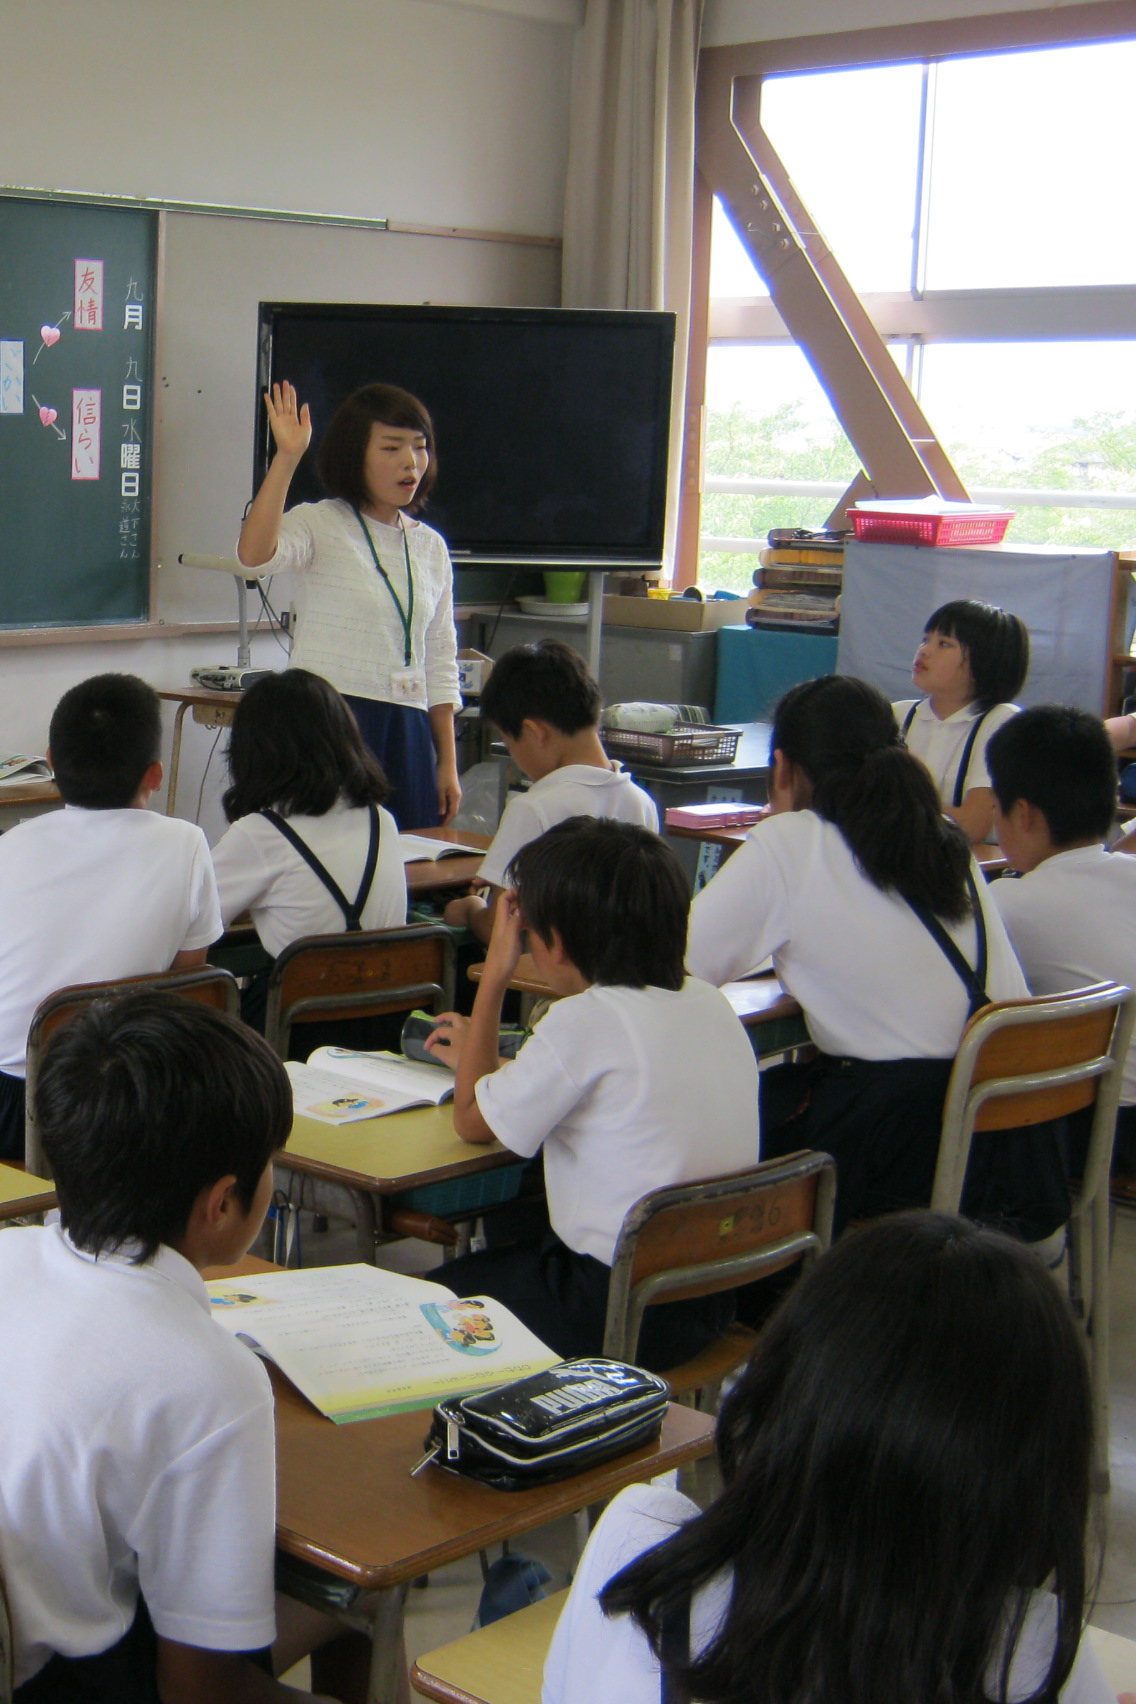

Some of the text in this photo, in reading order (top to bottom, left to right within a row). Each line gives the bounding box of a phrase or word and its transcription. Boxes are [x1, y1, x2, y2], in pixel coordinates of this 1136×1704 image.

[78, 266, 99, 326] 友情
[75, 396, 97, 474] 信らい
[529, 1379, 622, 1416] PUMA
